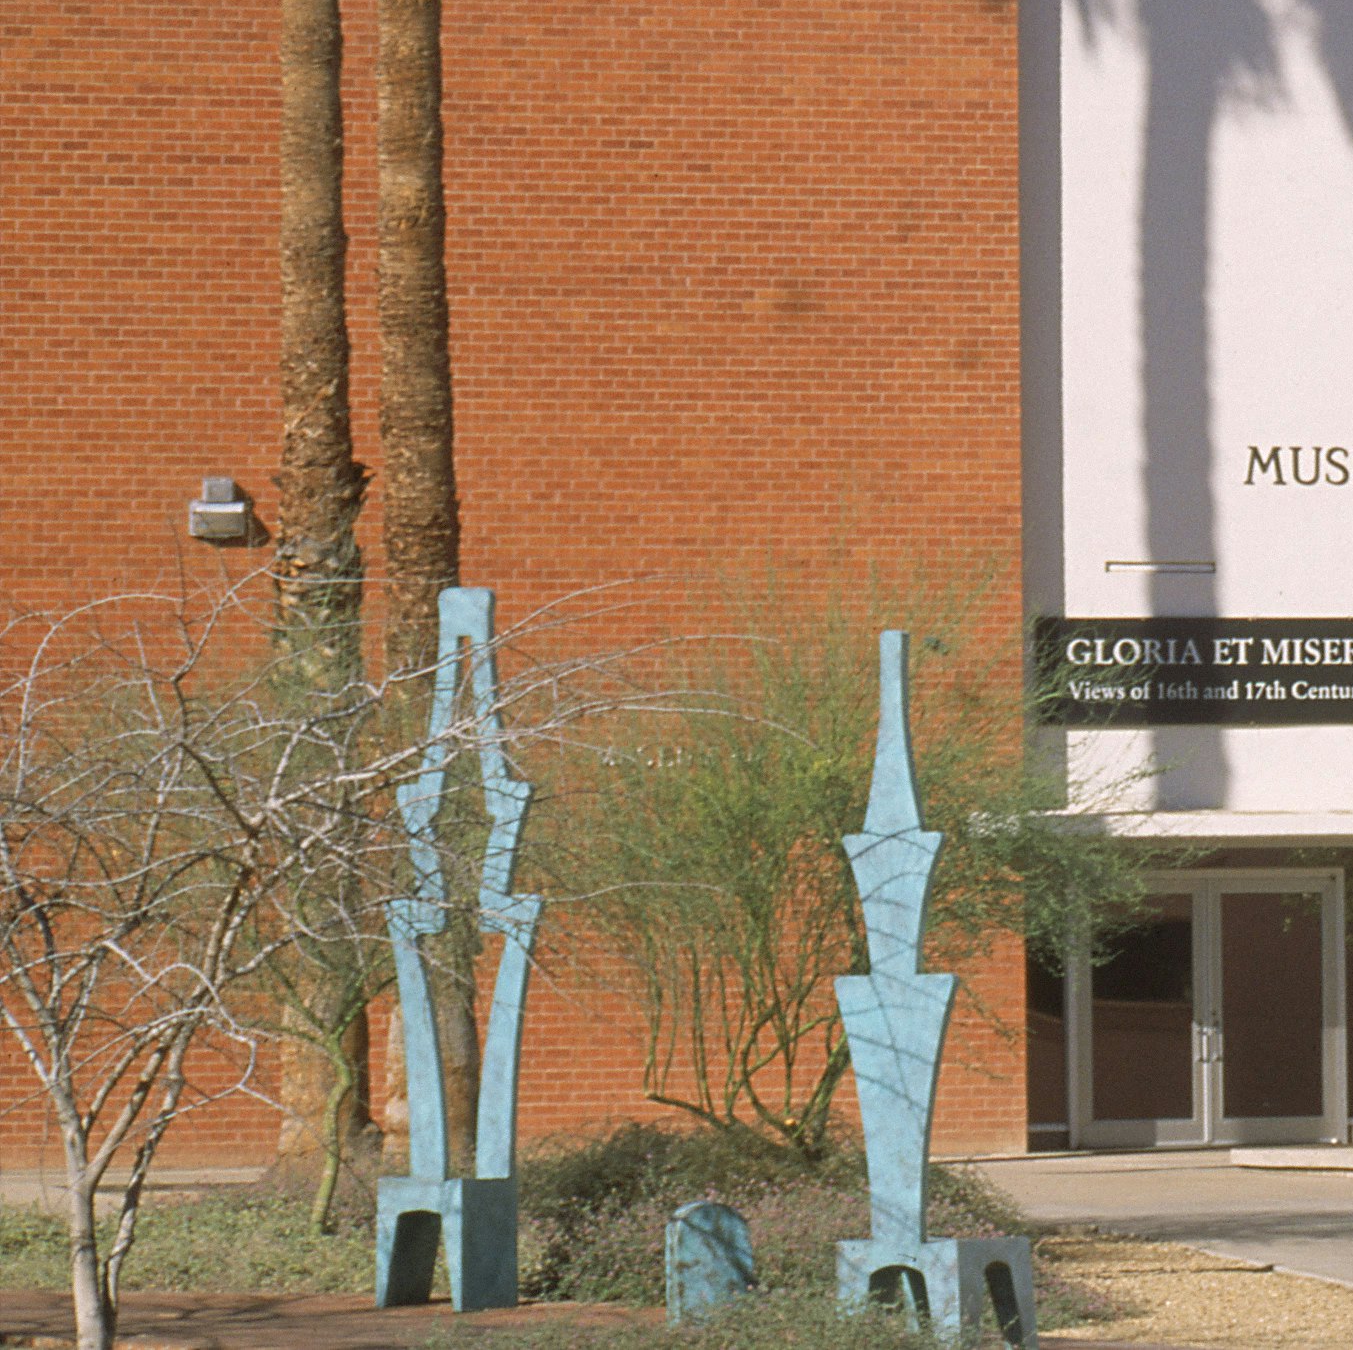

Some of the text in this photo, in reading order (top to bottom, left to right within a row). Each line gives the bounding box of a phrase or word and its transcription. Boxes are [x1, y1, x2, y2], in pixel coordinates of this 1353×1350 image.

[1066, 637, 1202, 665] GLORIA
[1213, 637, 1254, 665] ET
[1068, 681, 1127, 700] Views
[1130, 680, 1151, 700] of
[1157, 680, 1198, 700] 16th
[1203, 680, 1239, 700] and
[1245, 679, 1287, 700] 17th
